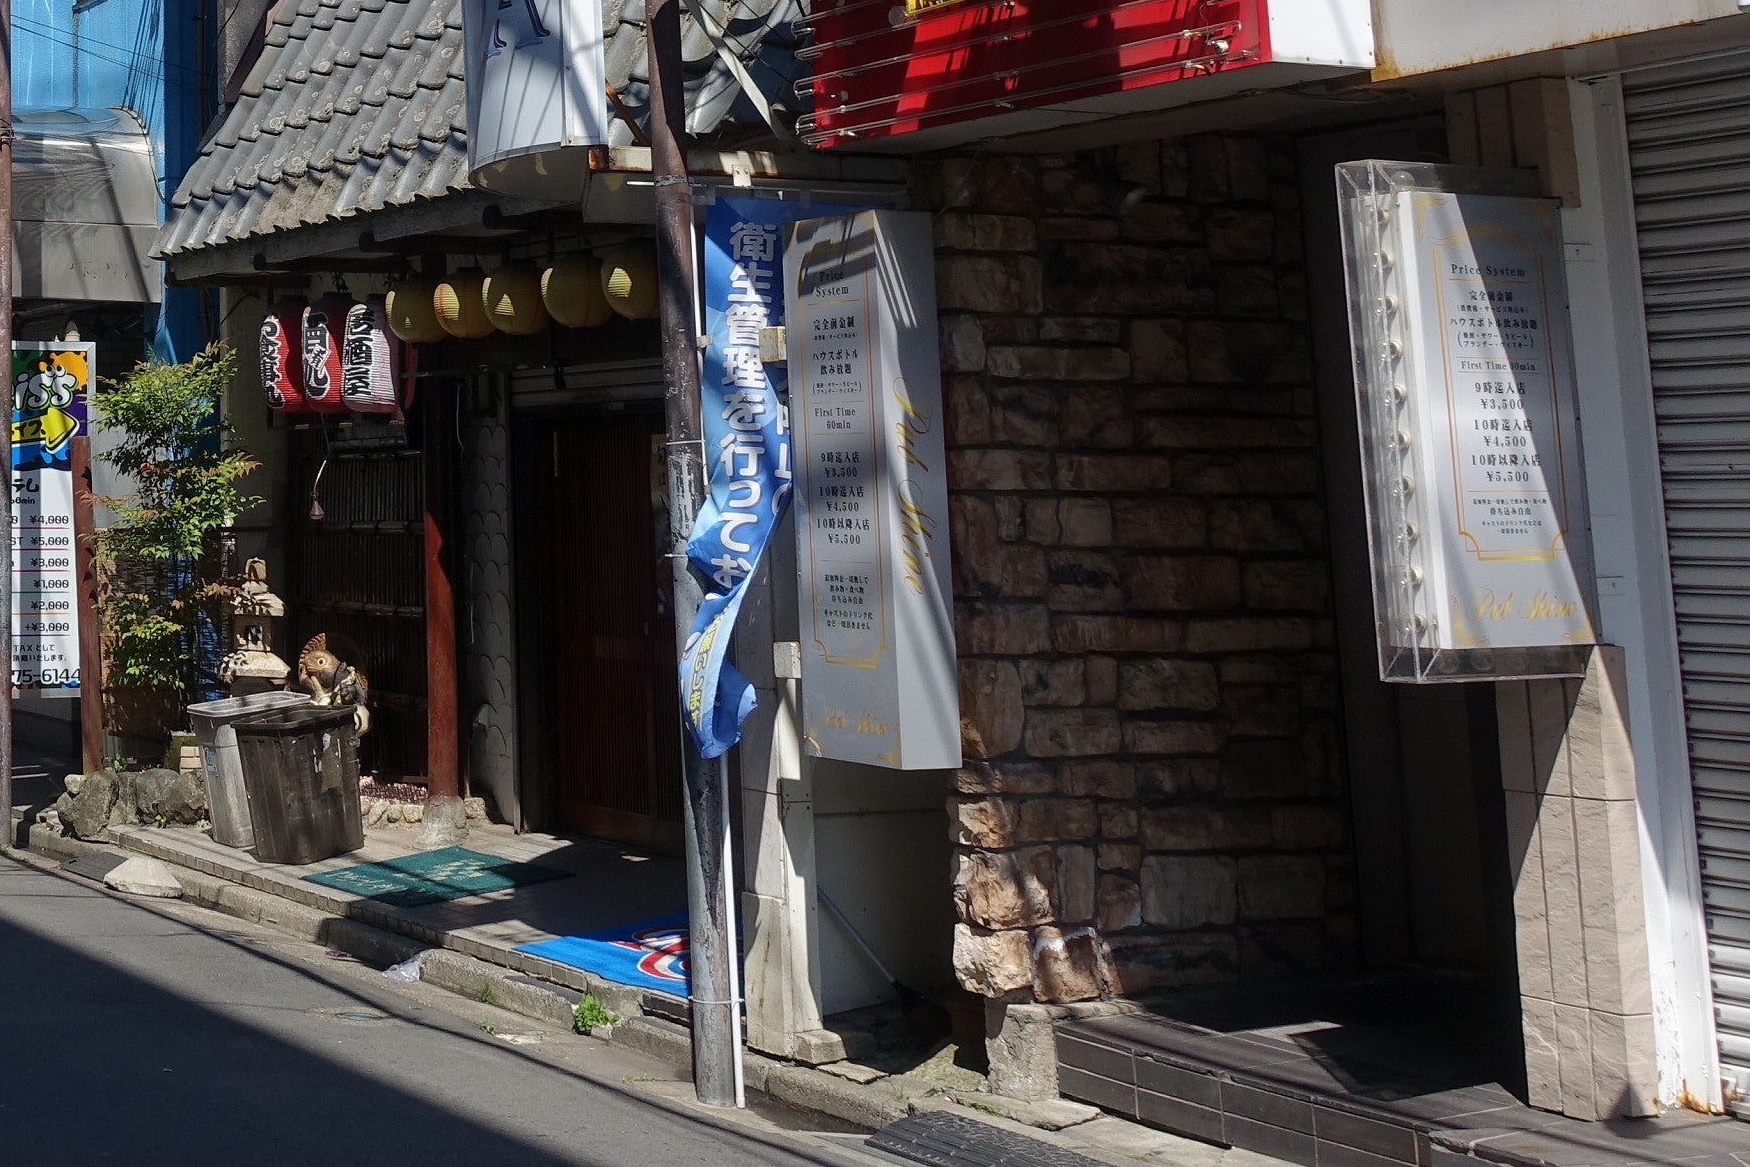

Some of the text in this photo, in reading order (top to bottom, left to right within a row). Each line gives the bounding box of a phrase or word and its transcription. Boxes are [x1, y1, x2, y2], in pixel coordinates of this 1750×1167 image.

[819, 270, 845, 281] Price
[1451, 264, 1526, 277] Price System
[816, 285, 850, 298] System
[812, 348, 859, 362] ハウスボトル
[820, 363, 852, 375] 飲み放題
[1461, 360, 1536, 371] First Time 60min
[1480, 398, 1524, 410] ¥3,500
[814, 407, 856, 418] First Time
[826, 420, 851, 430] 60min
[1483, 435, 1527, 447] ¥4,500
[825, 466, 858, 479] ¥3,500
[1486, 471, 1530, 483] ¥5,500
[826, 500, 860, 513] ¥4,500
[29, 515, 69, 525] ¥4,000
[30, 536, 69, 546] ¥5,000
[828, 534, 861, 546] ¥5,500
[30, 558, 69, 567] ¥3,000
[33, 579, 69, 589] ¥1,000
[30, 601, 69, 610] ¥2,000
